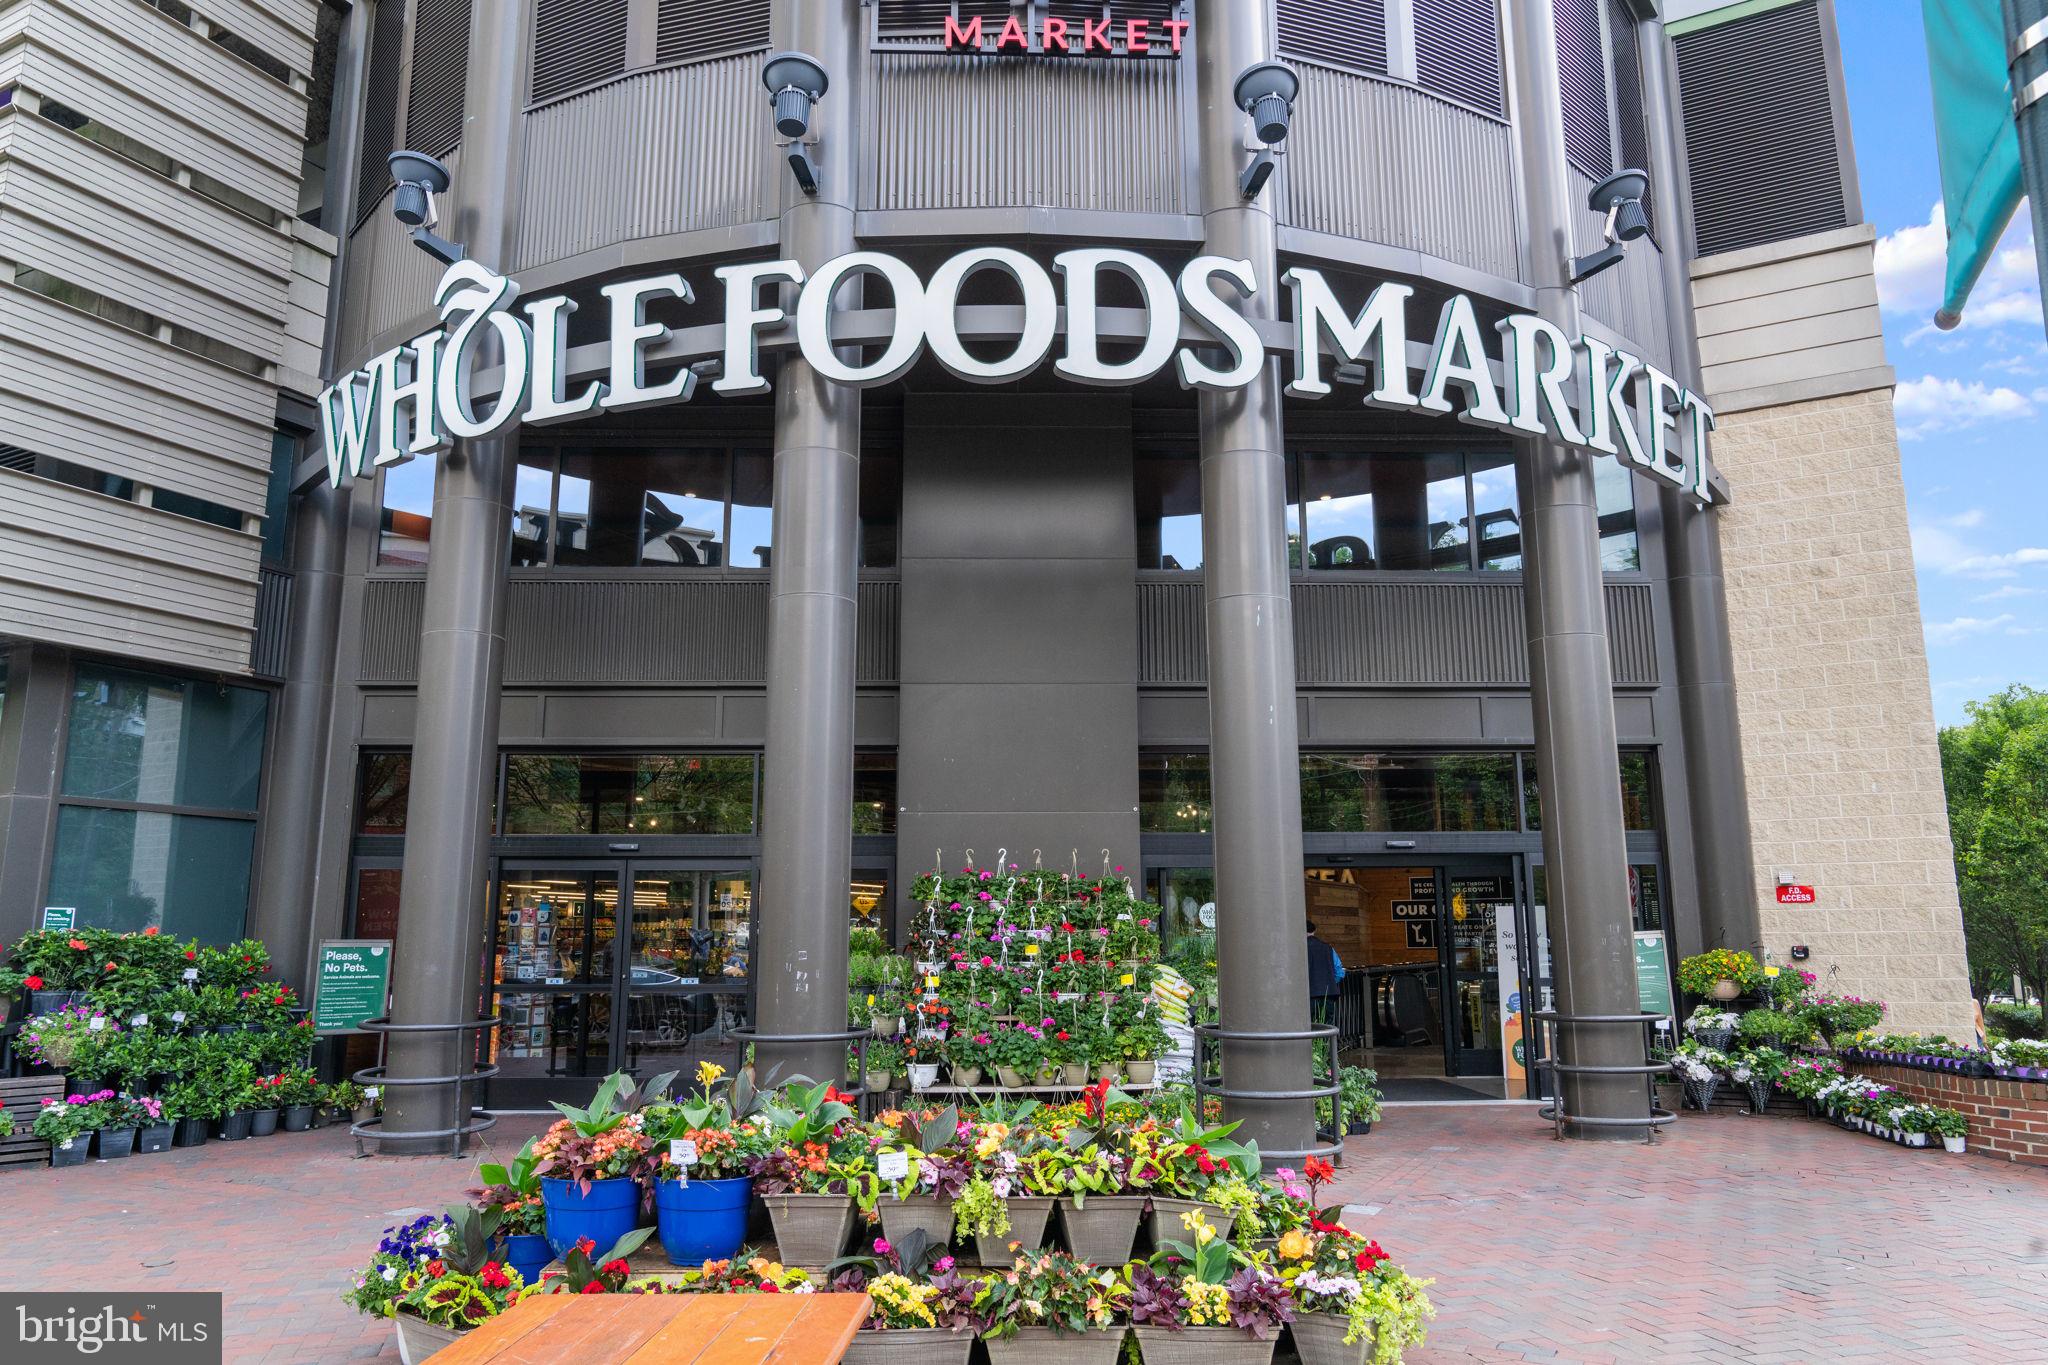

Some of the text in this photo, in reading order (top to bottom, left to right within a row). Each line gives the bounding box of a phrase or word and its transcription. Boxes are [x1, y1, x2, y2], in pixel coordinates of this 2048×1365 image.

[944, 15, 1190, 53] MARKET
[317, 247, 1716, 504] WHOLE FOODS MARKET
[1780, 894, 1811, 902] ACCESS
[1396, 904, 1428, 916] OUR
[326, 951, 362, 961] Please,
[325, 963, 368, 972] No Pets.
